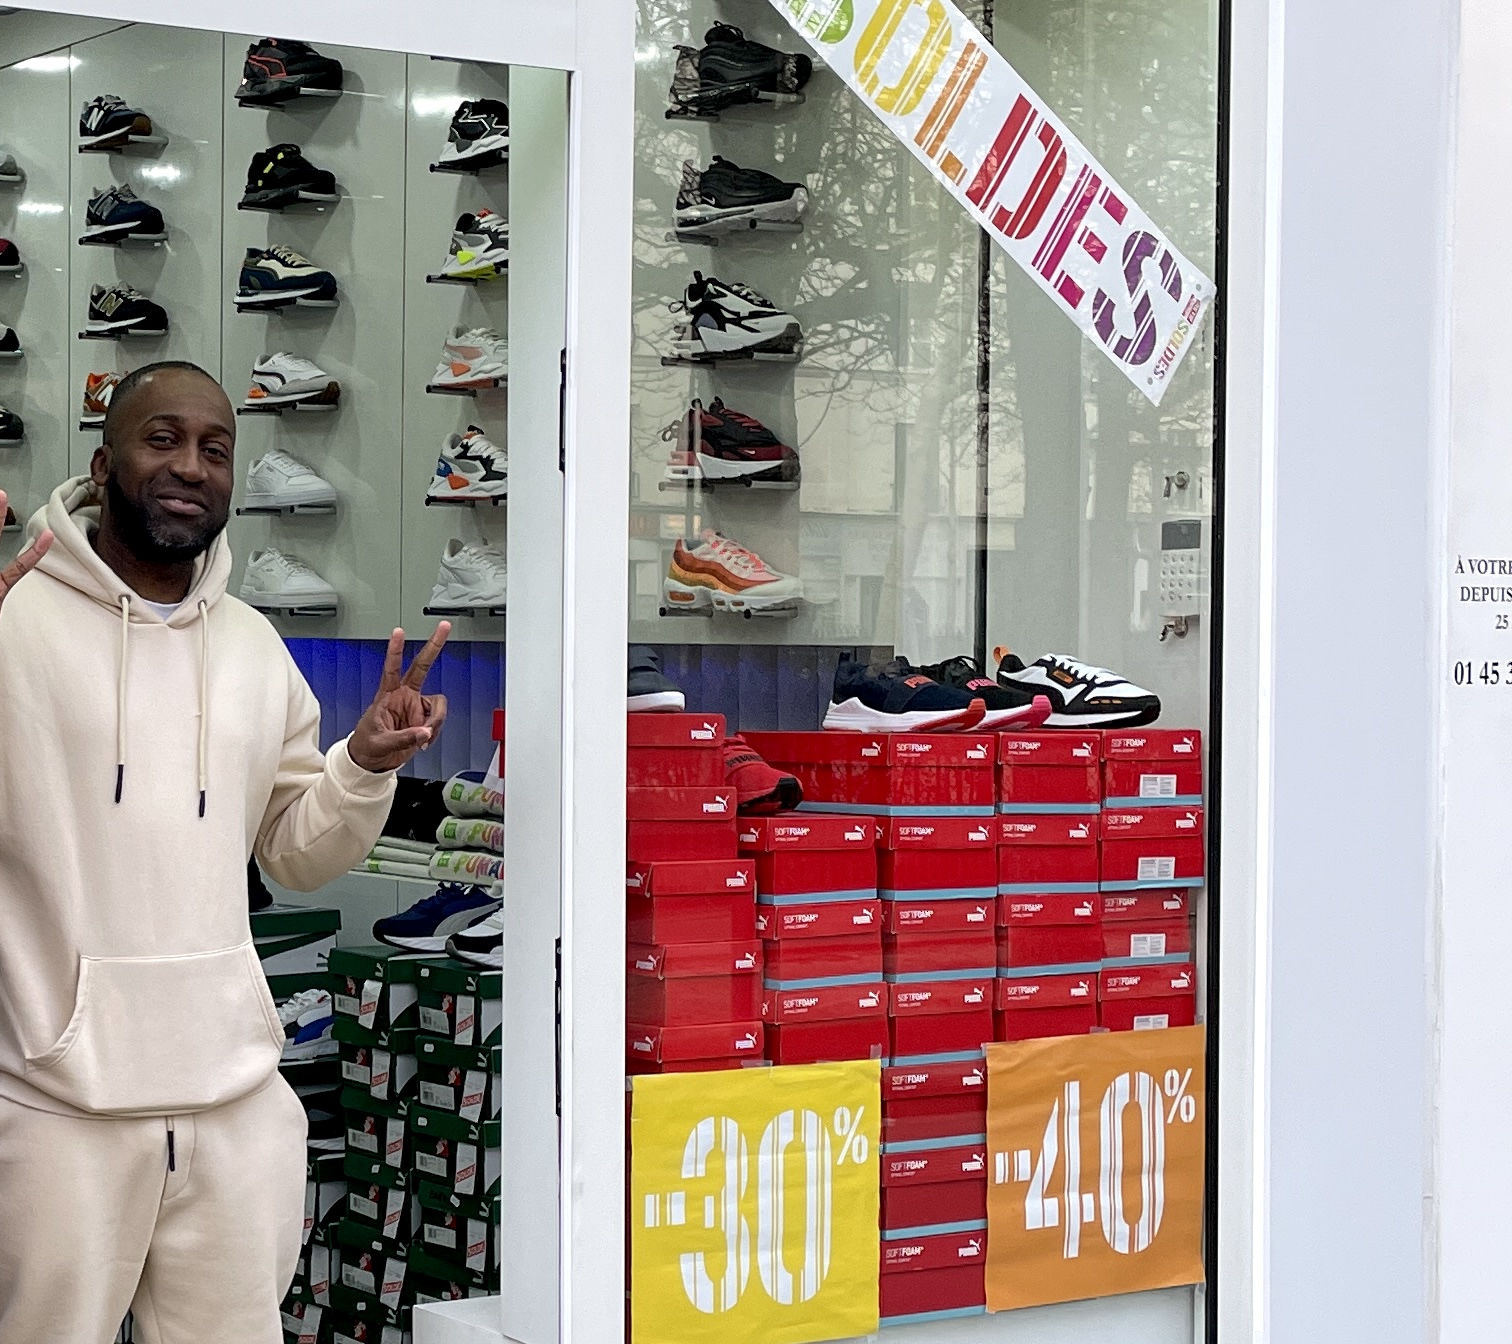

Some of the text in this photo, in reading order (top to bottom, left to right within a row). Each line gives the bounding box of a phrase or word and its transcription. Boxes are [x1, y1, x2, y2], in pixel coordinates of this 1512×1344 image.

[1153, 319, 1189, 380] SOLDES
[1454, 554, 1465, 575] À
[1460, 586, 1512, 602] DEPUIS
[1495, 614, 1509, 630] 25
[1454, 661, 1473, 685] 01
[1479, 661, 1500, 685] 45
[995, 1067, 1196, 1260] -40%
[644, 1105, 869, 1315] -30%
